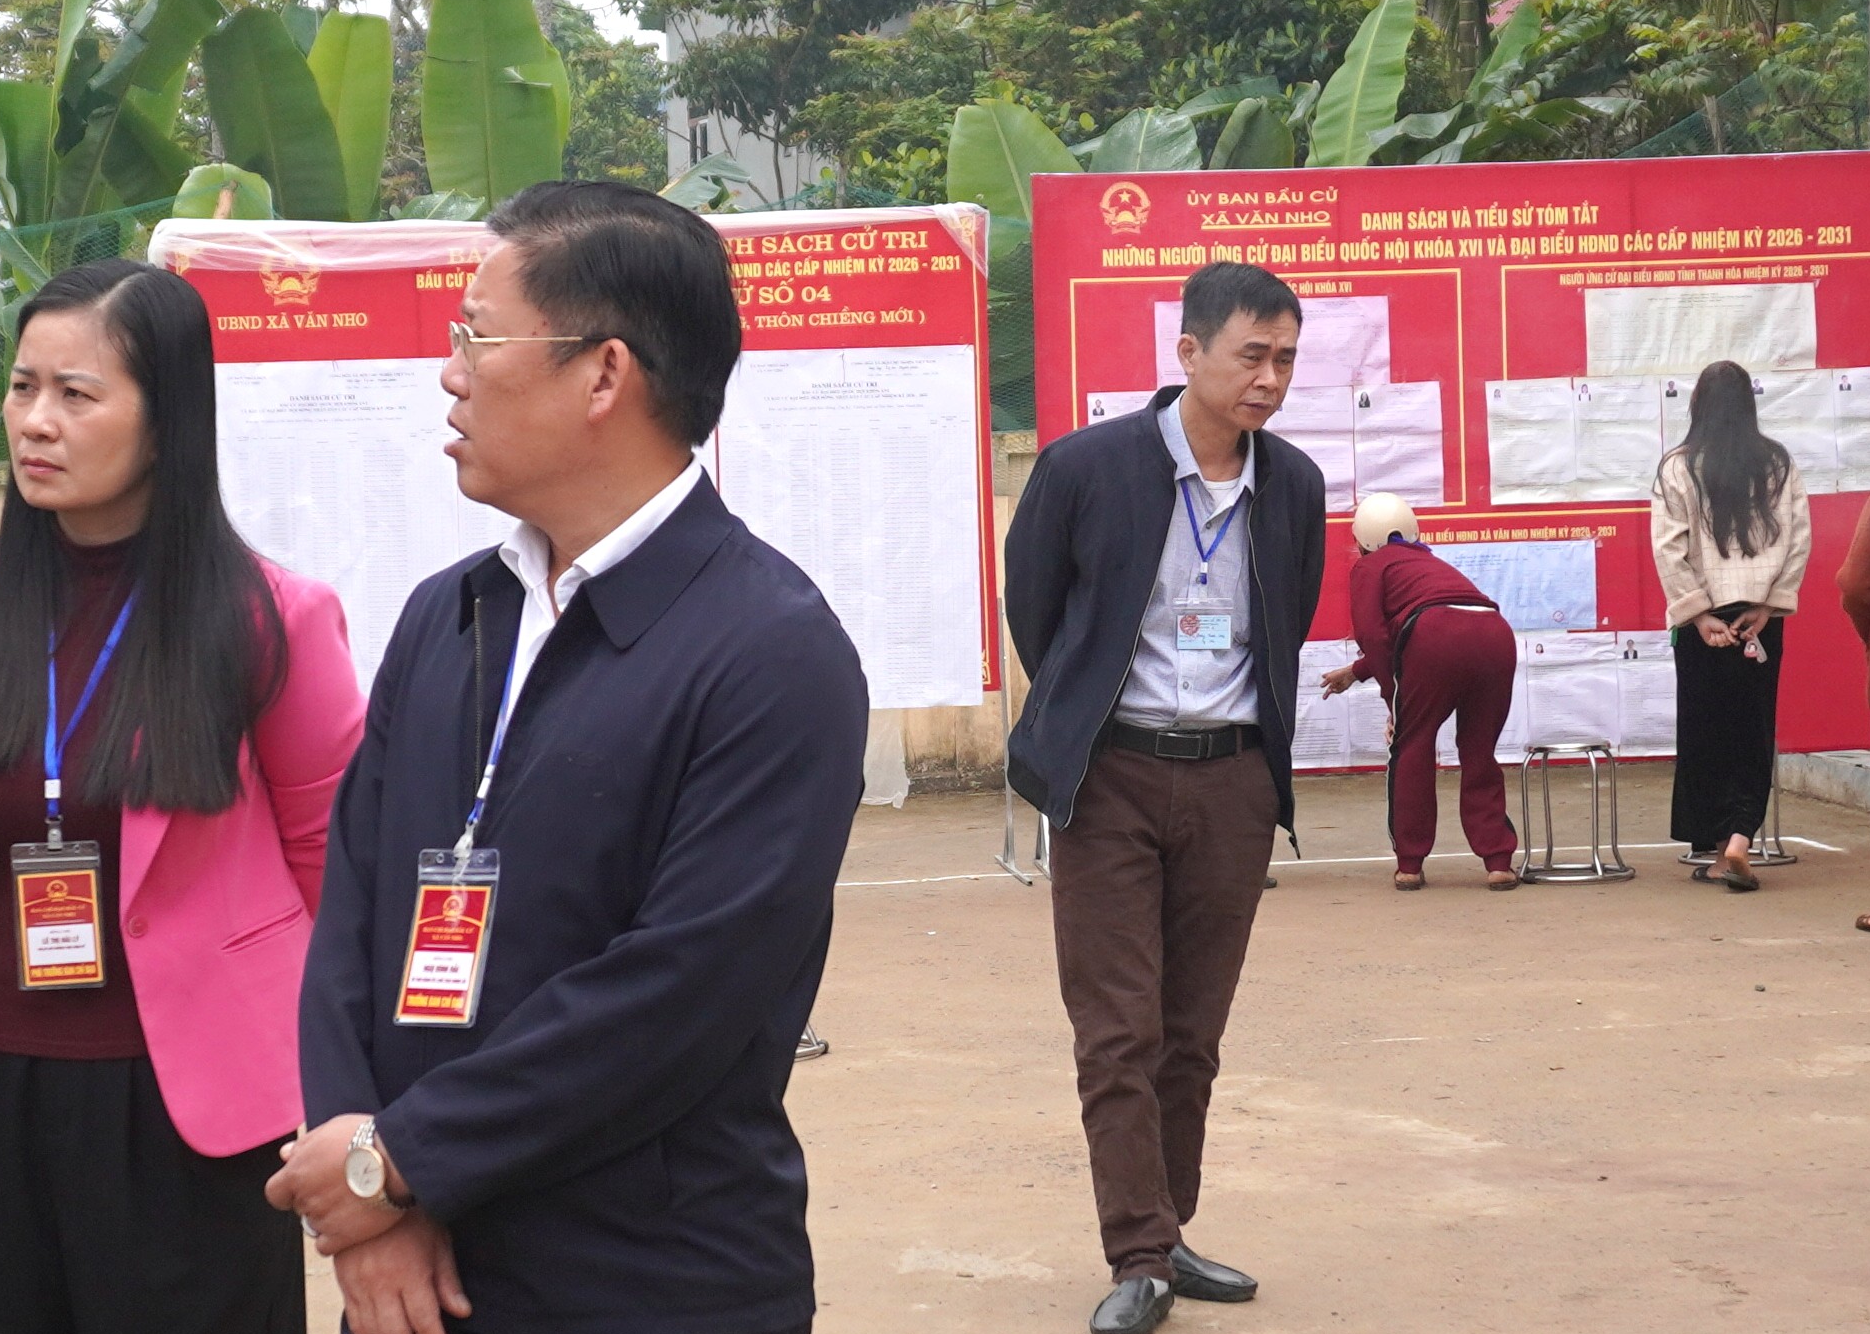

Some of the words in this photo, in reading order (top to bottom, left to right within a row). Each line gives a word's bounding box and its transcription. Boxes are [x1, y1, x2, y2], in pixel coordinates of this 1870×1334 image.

[1187, 189, 1212, 205] ỦY
[1218, 191, 1259, 205] BAN
[1265, 187, 1304, 204] BẦU
[1309, 186, 1339, 203] CỬ
[1201, 210, 1231, 225] XÃ
[1236, 210, 1279, 225] VĂN
[1285, 210, 1331, 224] NHO
[1361, 212, 1403, 231] DANH
[1407, 207, 1447, 229] SÁCH
[1452, 205, 1471, 228] VÀ
[1475, 201, 1508, 227] TIỂU
[1512, 200, 1534, 226] SỬ
[1536, 203, 1568, 225] TÓM
[762, 230, 833, 254] SÁCH
[841, 225, 877, 250] CỬ
[882, 231, 928, 249] TRI
[1102, 244, 1155, 267] NHỮNG
[1160, 242, 1206, 265] NGƯỜI
[1211, 240, 1242, 263] ỨNG
[1246, 237, 1269, 262] CỬ
[1271, 243, 1296, 267] ĐẠI
[1301, 236, 1336, 261] BIỂU
[1340, 236, 1380, 262] QUỐC
[1384, 238, 1409, 263] HỘI
[1414, 236, 1455, 258] KHÓA
[1458, 238, 1482, 258] XVI
[1487, 234, 1507, 256] VÀ
[1510, 236, 1535, 259] ĐẠI
[1540, 228, 1574, 254] BIỂU
[1578, 234, 1619, 253] HĐND
[1624, 231, 1653, 252] CÁC
[1657, 226, 1687, 250] CẤP
[1691, 227, 1740, 253] NHIỆM
[1744, 225, 1764, 247] KỲ
[1767, 228, 1803, 247] 2026
[1817, 226, 1851, 245] 2031
[765, 259, 791, 277] CÁC
[795, 255, 819, 276] CẤP
[823, 255, 865, 277] NHIỆM
[868, 254, 884, 273] KỲ
[888, 257, 919, 272] 2026
[931, 255, 961, 271] 2031
[1559, 272, 1584, 285] NGƯỜI
[1605, 269, 1617, 284] CỬ
[1618, 272, 1631, 285] ĐẠI
[1634, 268, 1652, 283] BIỂU
[1653, 272, 1675, 282] HĐND
[1677, 267, 1696, 282] TỈNH
[1698, 269, 1724, 281] THANH
[1725, 267, 1741, 280] HÓA
[1743, 265, 1769, 281] NHIỆM
[1771, 265, 1782, 278] KỲ
[1784, 266, 1803, 277] 2026
[1810, 265, 1829, 276] 2031
[416, 268, 441, 289] BẦU
[445, 267, 465, 288] CỬ
[1299, 281, 1313, 296] HỘI
[1315, 281, 1337, 294] KHÓA
[1339, 282, 1352, 293] XVI
[759, 277, 796, 304] SỐ
[801, 285, 831, 303] 04
[217, 316, 262, 331] UBND
[266, 311, 289, 329] XÃ
[294, 310, 328, 328] VĂN
[332, 312, 368, 327] NHO
[755, 310, 803, 328] THÔN
[809, 306, 875, 326] CHIỀNG
[880, 307, 914, 323] MỚI
[1436, 528, 1454, 542] BIỂU
[1456, 531, 1478, 541] HĐND
[1493, 528, 1510, 540] VĂN
[1511, 529, 1529, 540] NHO
[1531, 525, 1556, 541] NHIỆM
[1558, 525, 1569, 538] KỲ
[1598, 526, 1616, 537] 2031
